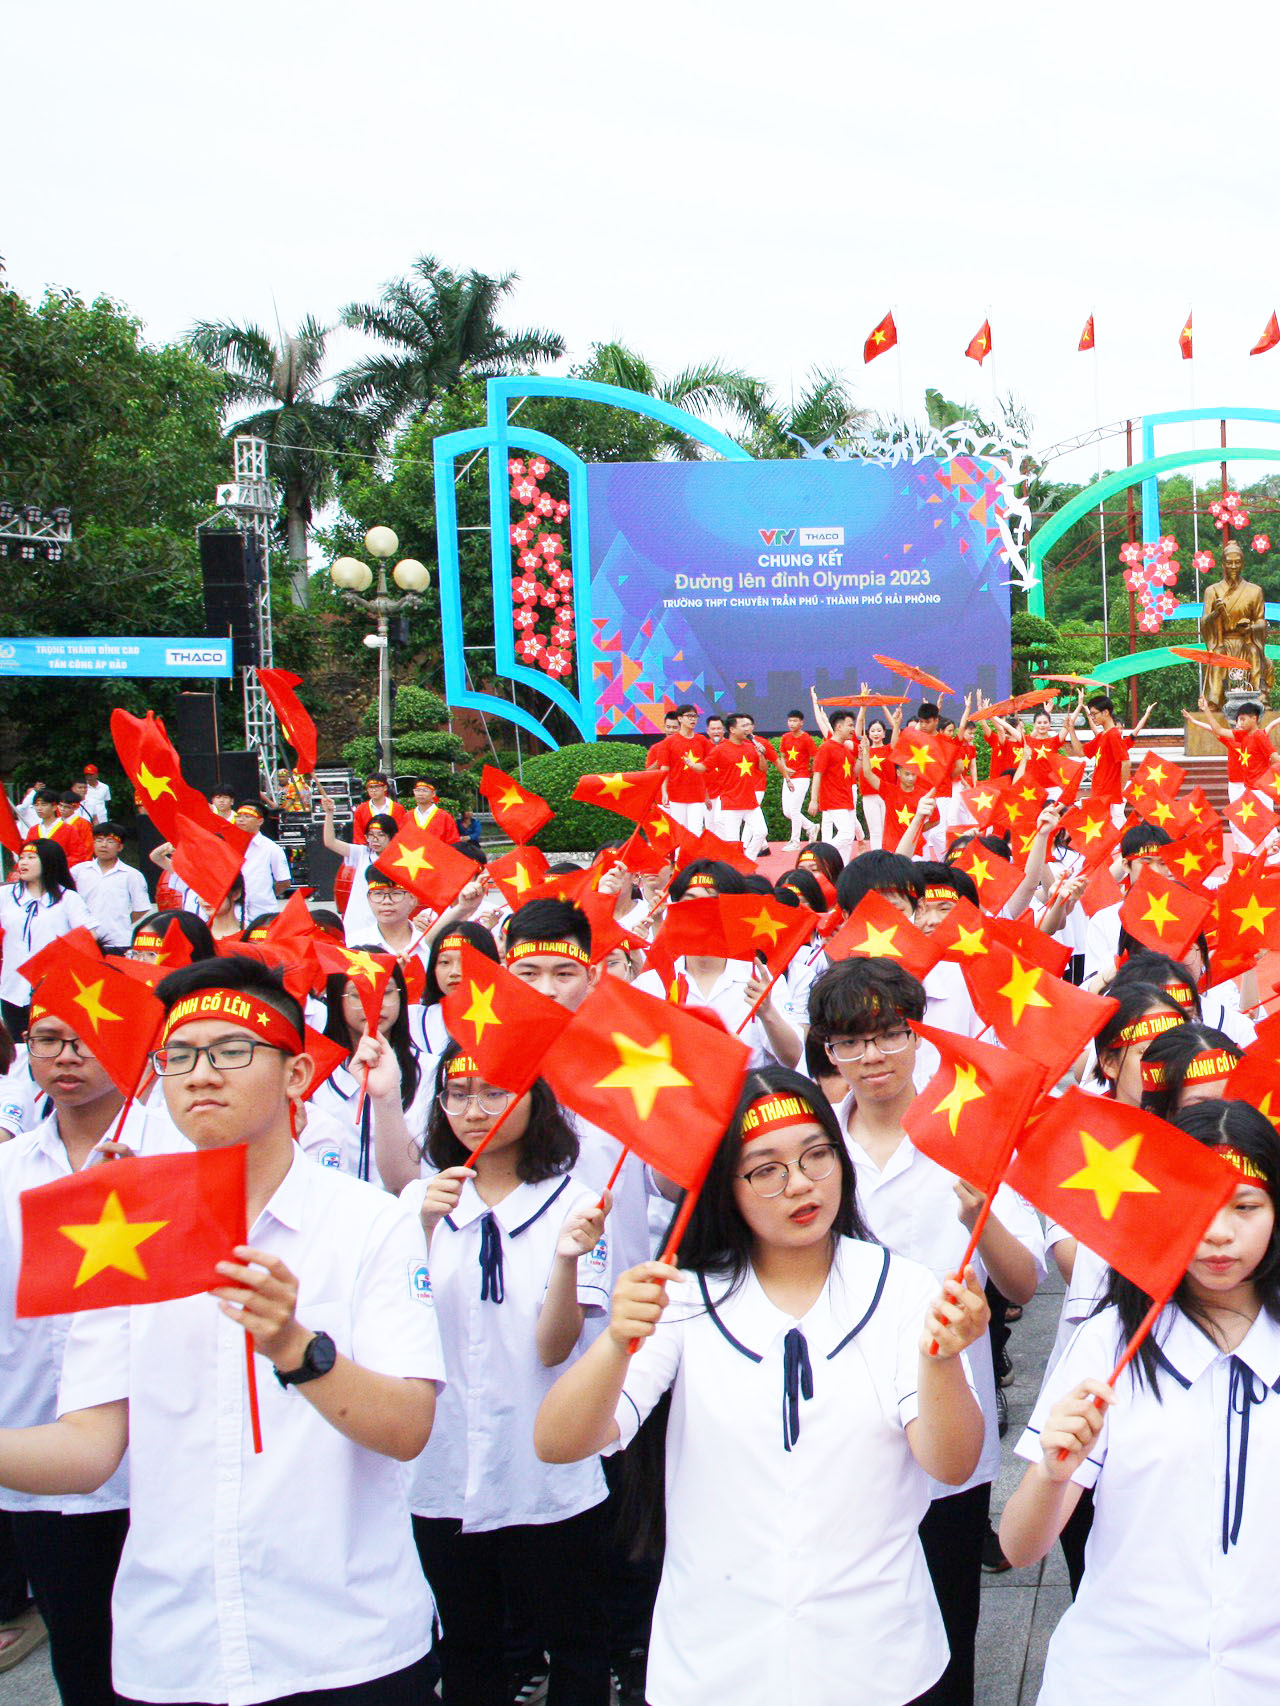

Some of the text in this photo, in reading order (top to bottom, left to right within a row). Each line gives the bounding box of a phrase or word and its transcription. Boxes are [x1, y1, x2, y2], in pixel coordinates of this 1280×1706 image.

[759, 529, 796, 546] VTV
[758, 548, 843, 567] CHUNG KẾT
[675, 570, 930, 592] Đường lên đỉnh Olympia 2023
[663, 597, 702, 608] TRƯỜNG
[705, 598, 728, 608] THPT
[730, 596, 769, 607] CHUYÊN
[771, 595, 796, 606] TRẦN
[799, 594, 818, 606] PHÚ
[826, 594, 858, 606] THÀNH
[861, 592, 882, 605] PHỐ
[885, 592, 902, 605] HẢI
[904, 594, 941, 604] PHÒNG
[170, 652, 223, 662] THACO
[200, 991, 224, 1010] CỐ
[223, 996, 250, 1019] LÊN
[1216, 1051, 1230, 1073] CỐ
[758, 1097, 801, 1122] THÀNH
